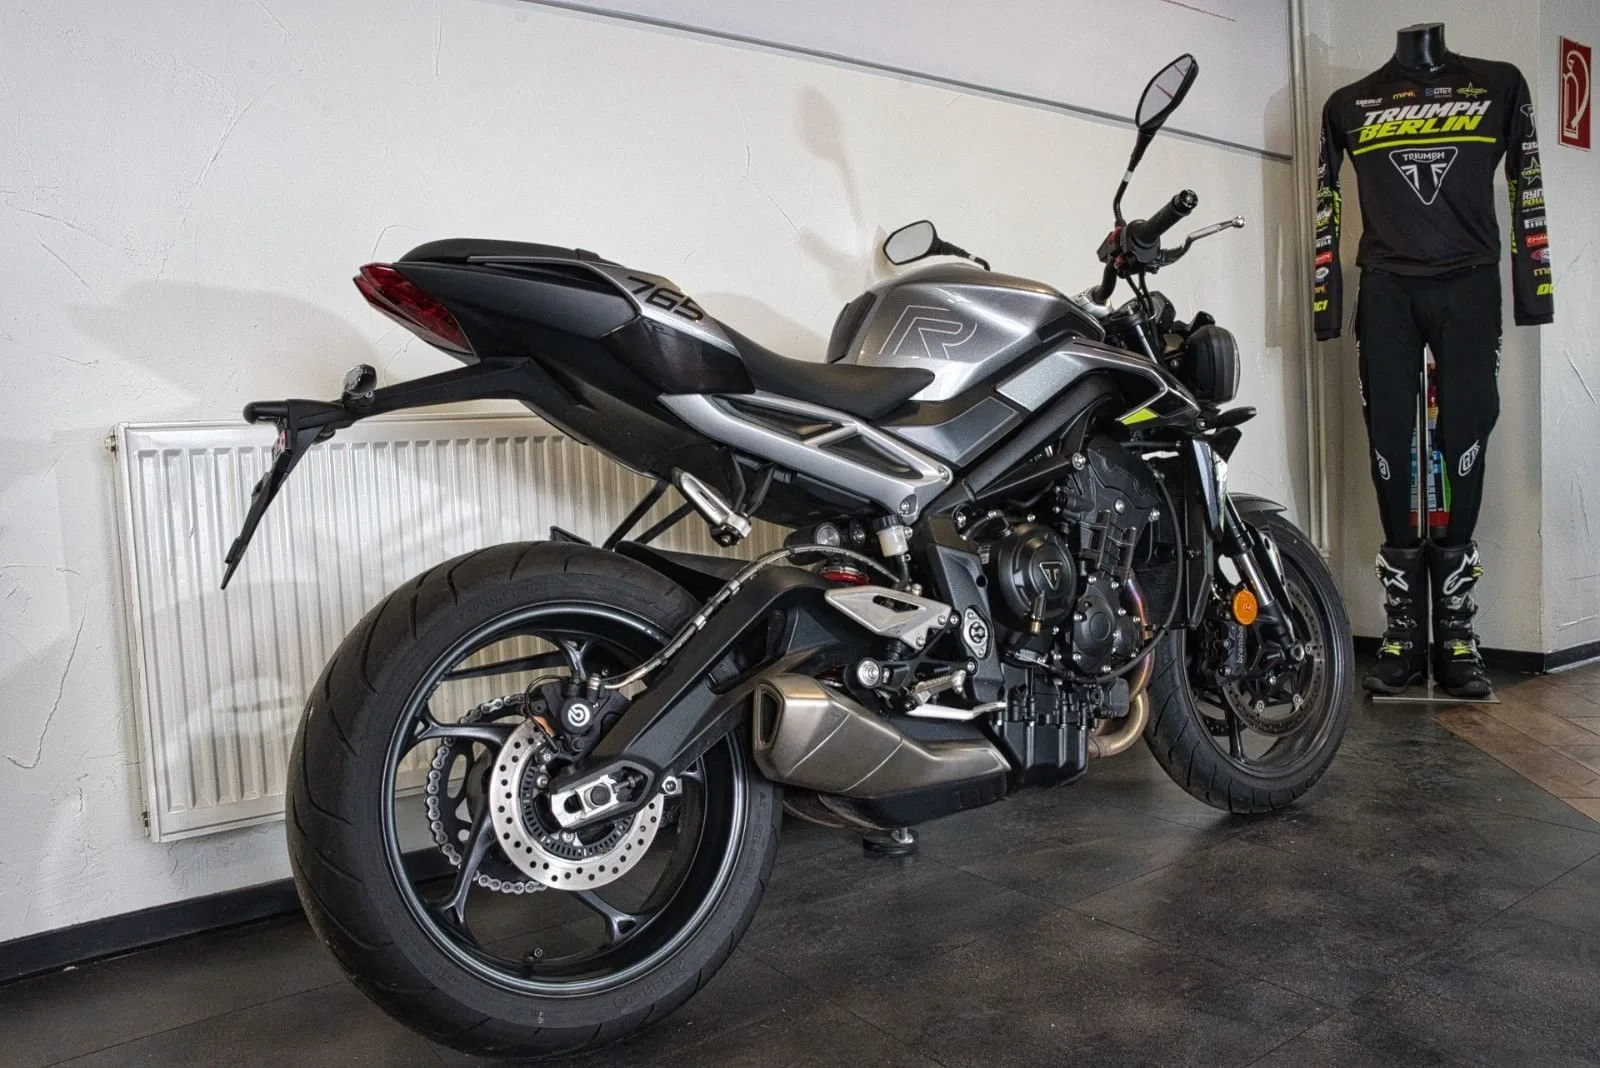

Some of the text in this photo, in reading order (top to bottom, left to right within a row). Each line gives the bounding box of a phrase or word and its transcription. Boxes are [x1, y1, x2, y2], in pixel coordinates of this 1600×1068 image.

[1363, 101, 1492, 127] TRIUMPH
[1358, 115, 1484, 144] BERLIN
[1402, 152, 1445, 161] TRIUMPH
[626, 275, 704, 321] 765
[1236, 625, 1244, 664] brembo
